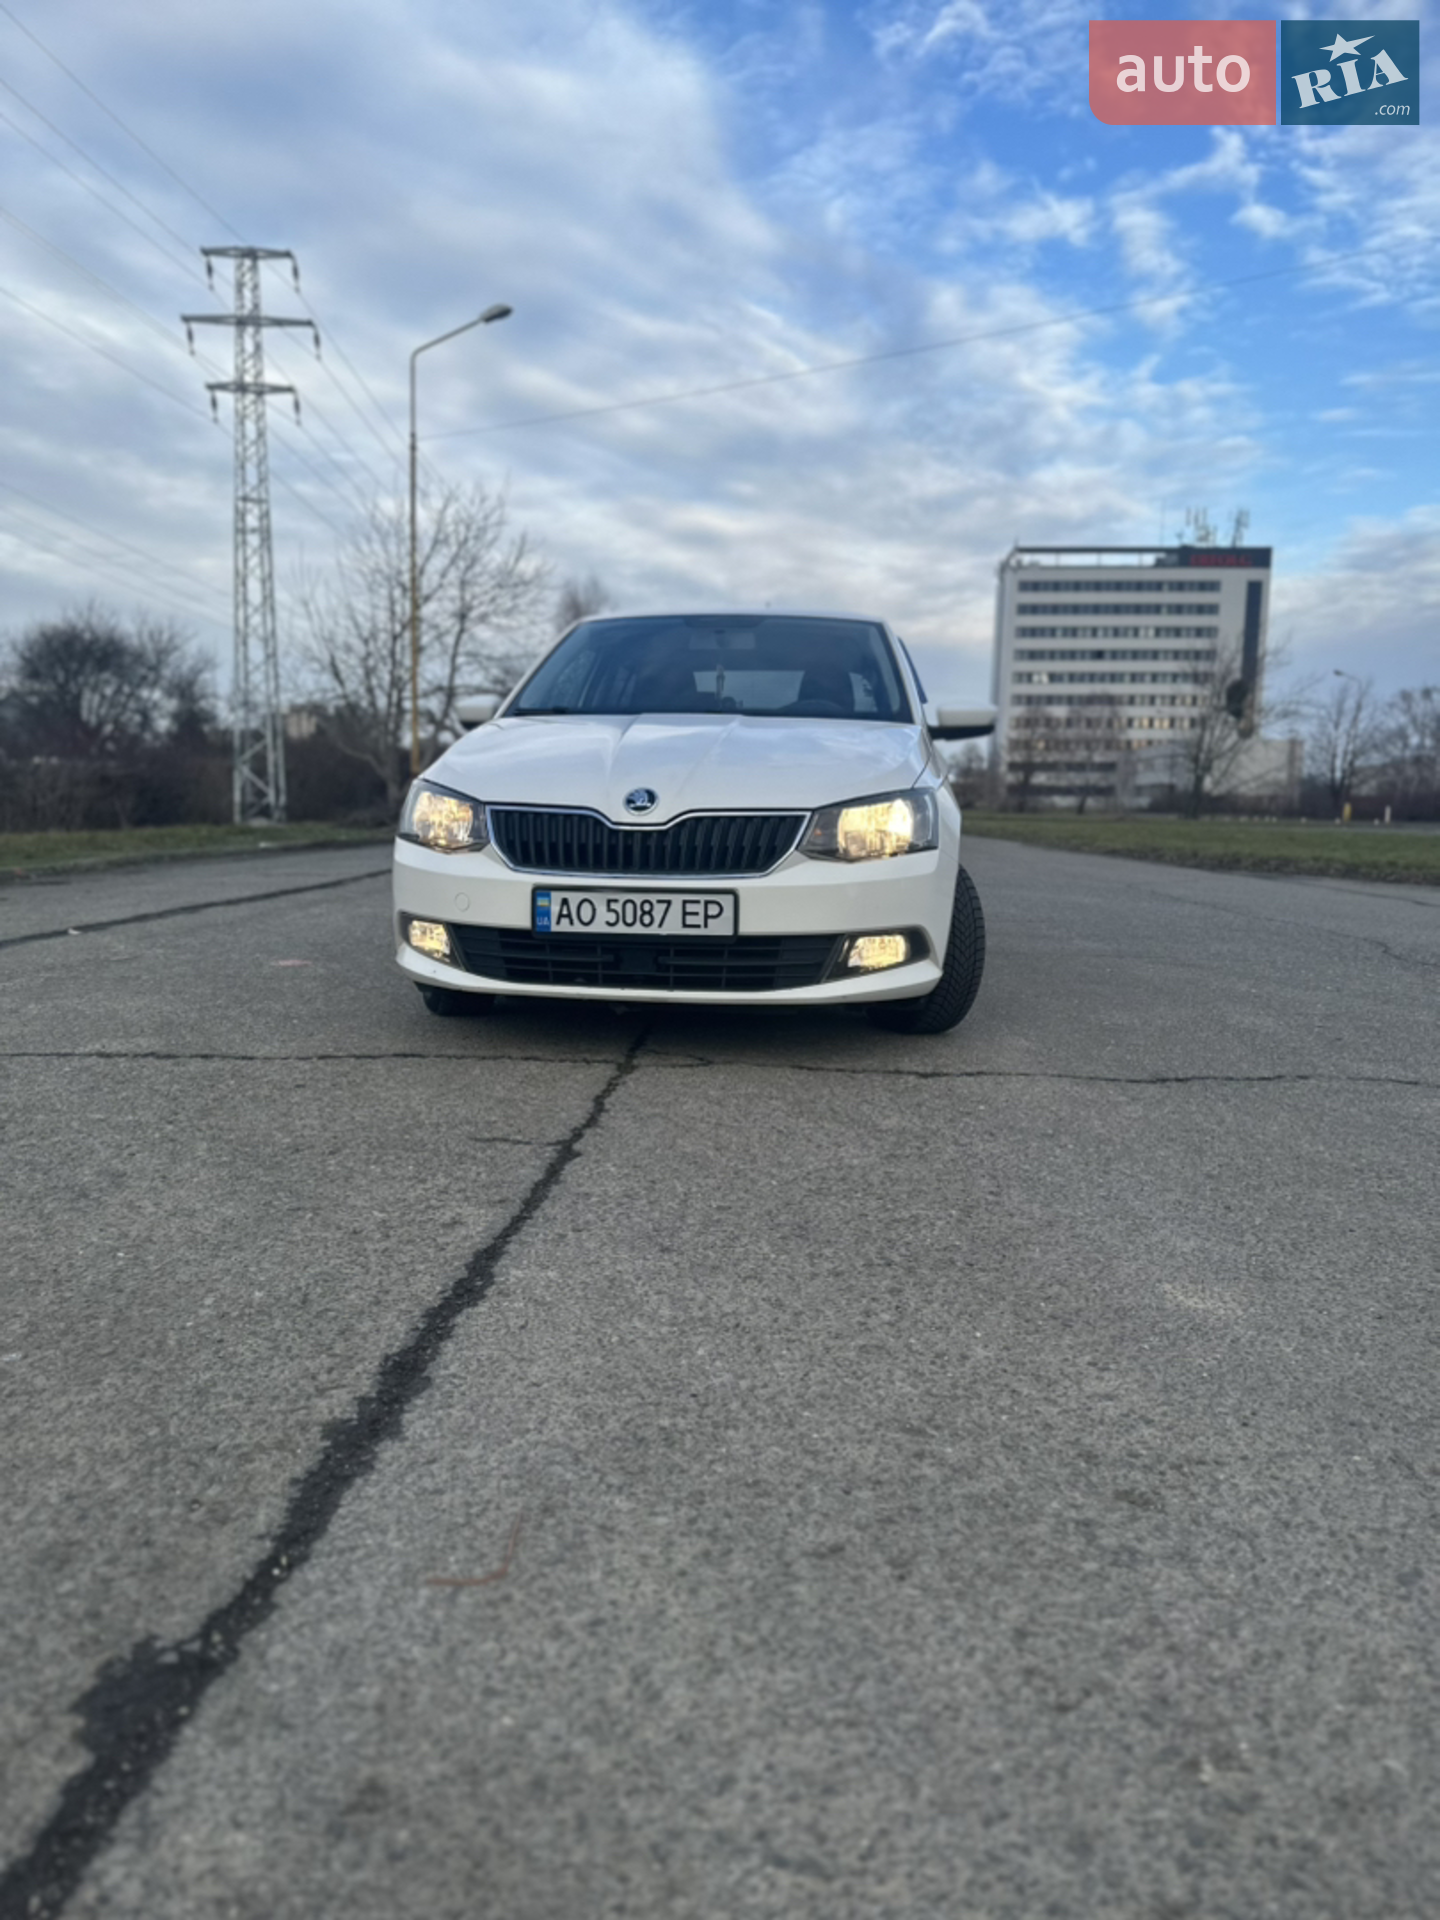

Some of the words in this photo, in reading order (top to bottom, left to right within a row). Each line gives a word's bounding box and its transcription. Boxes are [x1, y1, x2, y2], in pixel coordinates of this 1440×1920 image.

[536, 916, 550, 926] UA
[555, 897, 597, 927] AO
[604, 898, 673, 929] 5087
[681, 899, 724, 929] EP
